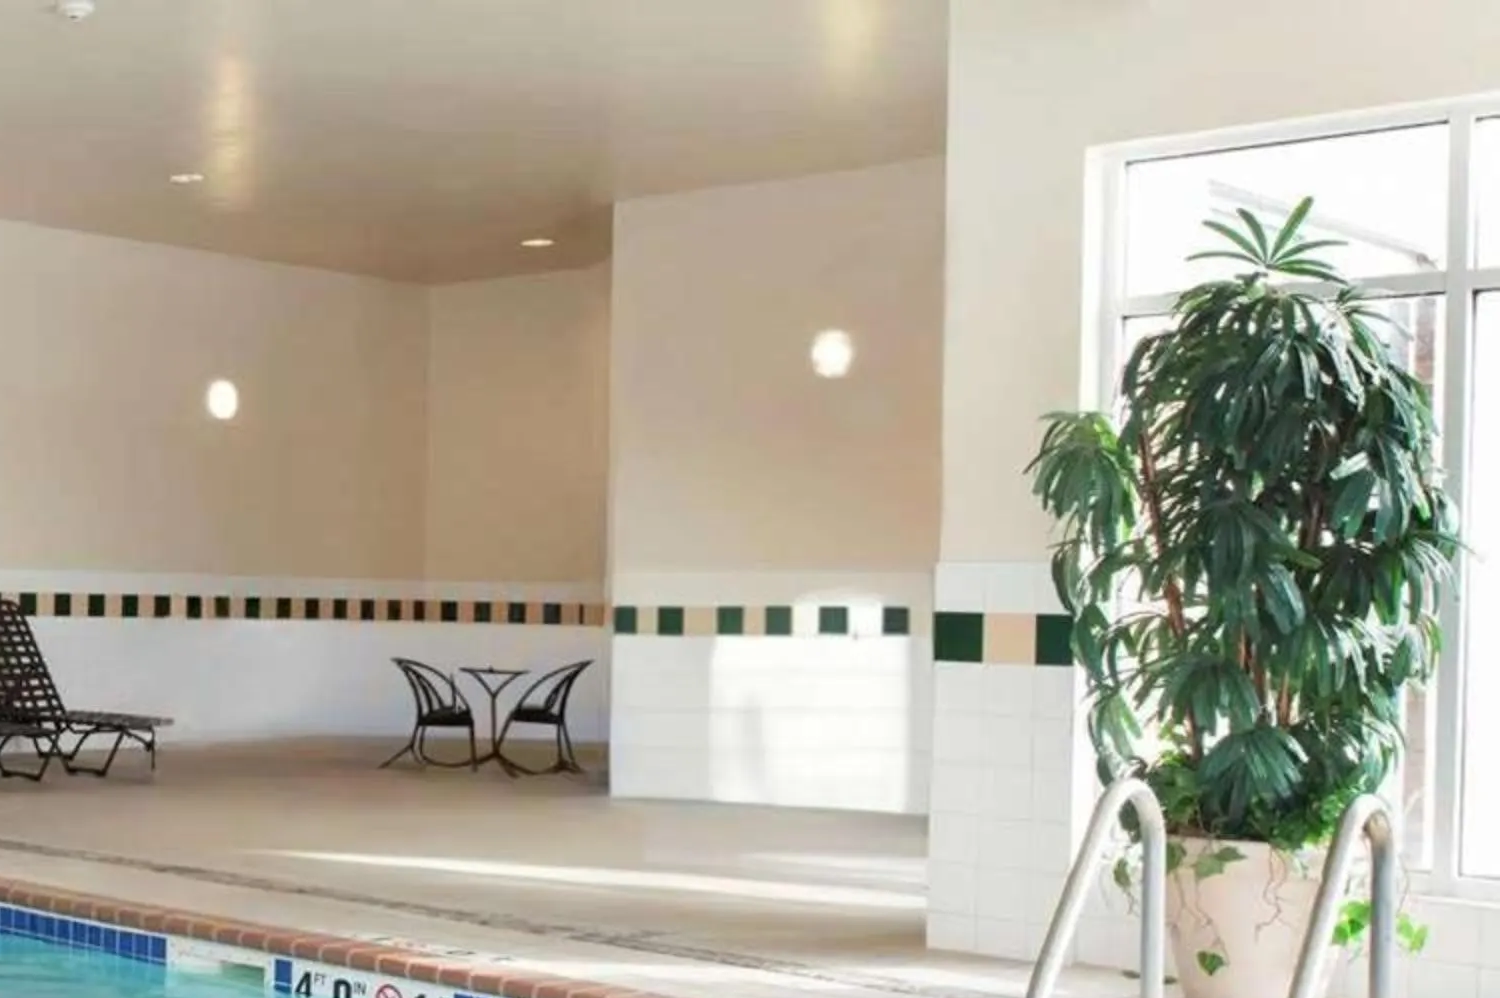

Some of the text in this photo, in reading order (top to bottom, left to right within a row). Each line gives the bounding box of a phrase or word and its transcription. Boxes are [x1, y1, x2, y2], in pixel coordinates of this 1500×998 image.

[295, 971, 312, 998] 4
[314, 972, 326, 986] FT
[354, 981, 367, 996] IN
